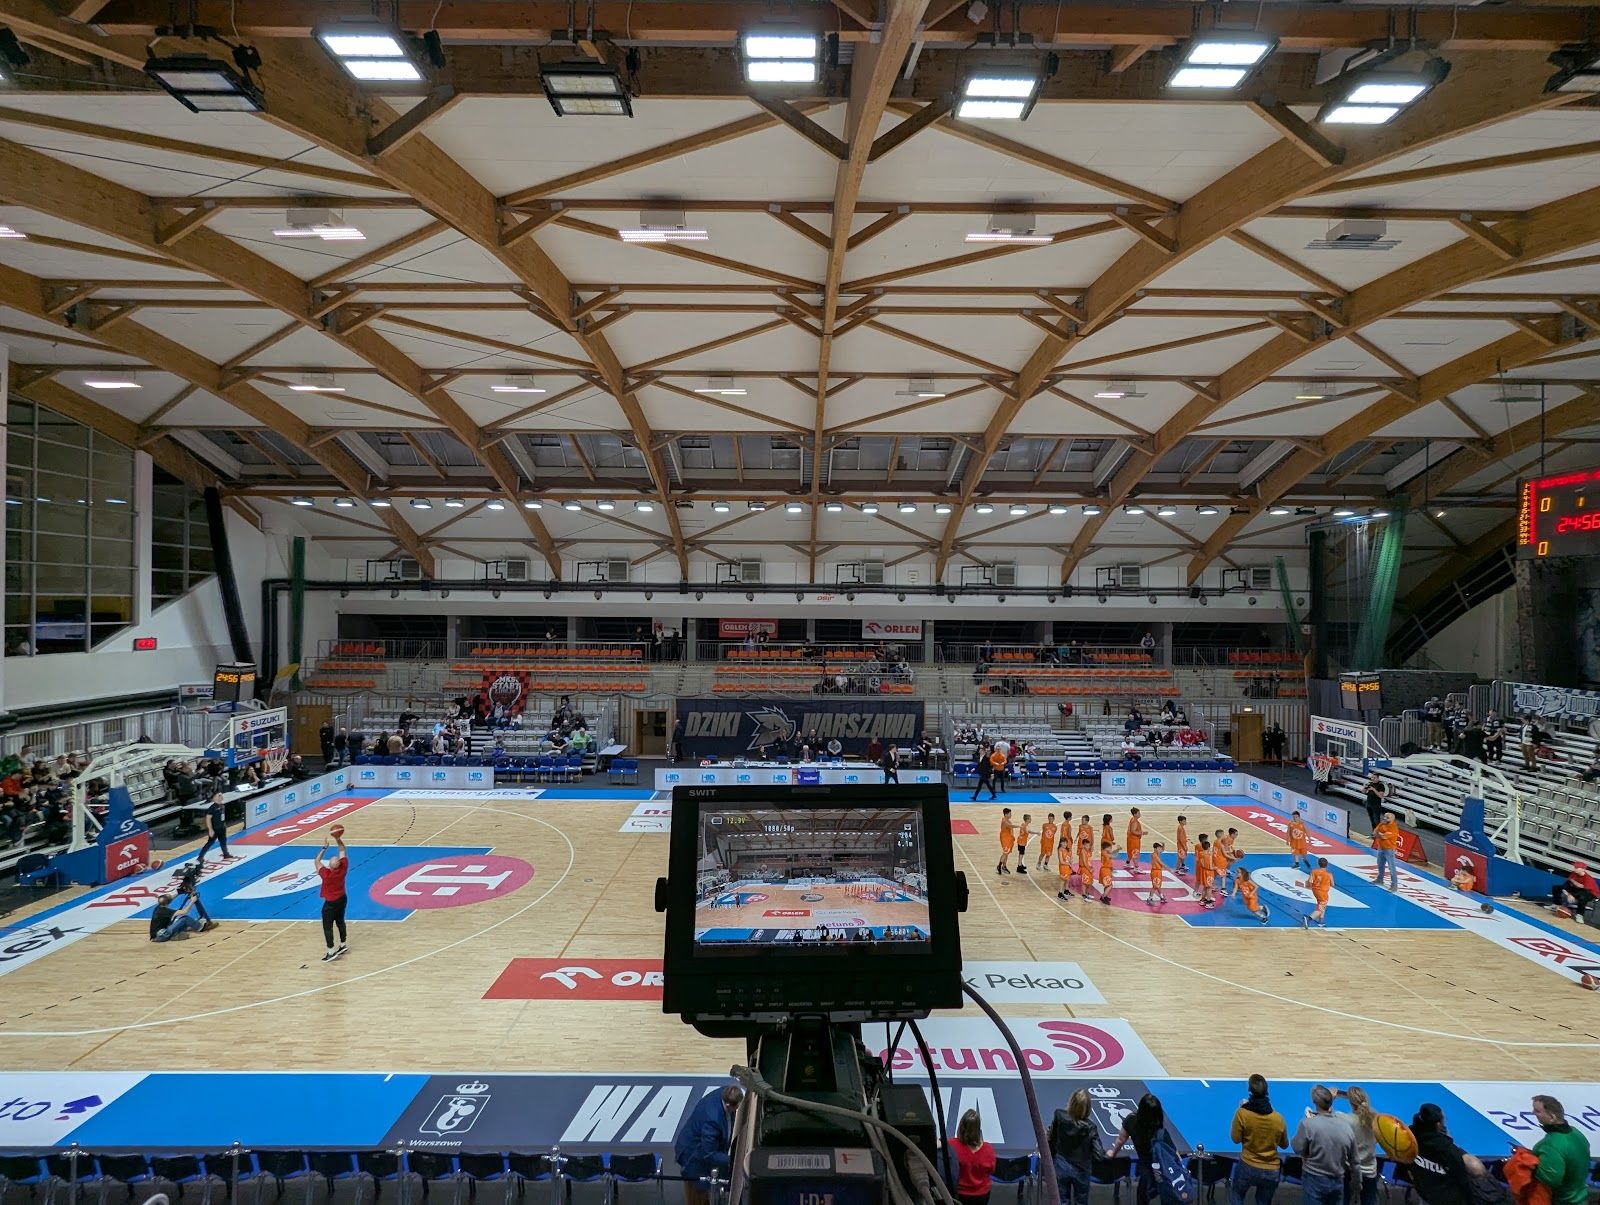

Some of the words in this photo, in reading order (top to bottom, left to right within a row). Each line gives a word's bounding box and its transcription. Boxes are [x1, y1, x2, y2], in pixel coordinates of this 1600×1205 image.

[1540, 497, 1551, 512] 0
[1578, 496, 1585, 507] 1
[1558, 513, 1600, 533] 24:56
[1538, 541, 1549, 556] 0
[884, 624, 920, 634] ORLEN
[216, 673, 239, 683] 24:56
[1358, 682, 1380, 692] 24:56
[250, 714, 280, 728] SUZUKI
[684, 711, 742, 737] DZIKI
[800, 713, 916, 739] WARSZAWA
[1326, 725, 1357, 738] SUZUKI
[688, 789, 717, 797] SWIT
[297, 802, 355, 825] ORLEN
[117, 858, 140, 871] ORLEN
[1261, 872, 1315, 900] SUZUKI
[984, 973, 1084, 990] Pekao
[865, 1040, 1055, 1071] etuno
[409, 1139, 463, 1147] Warszawa
